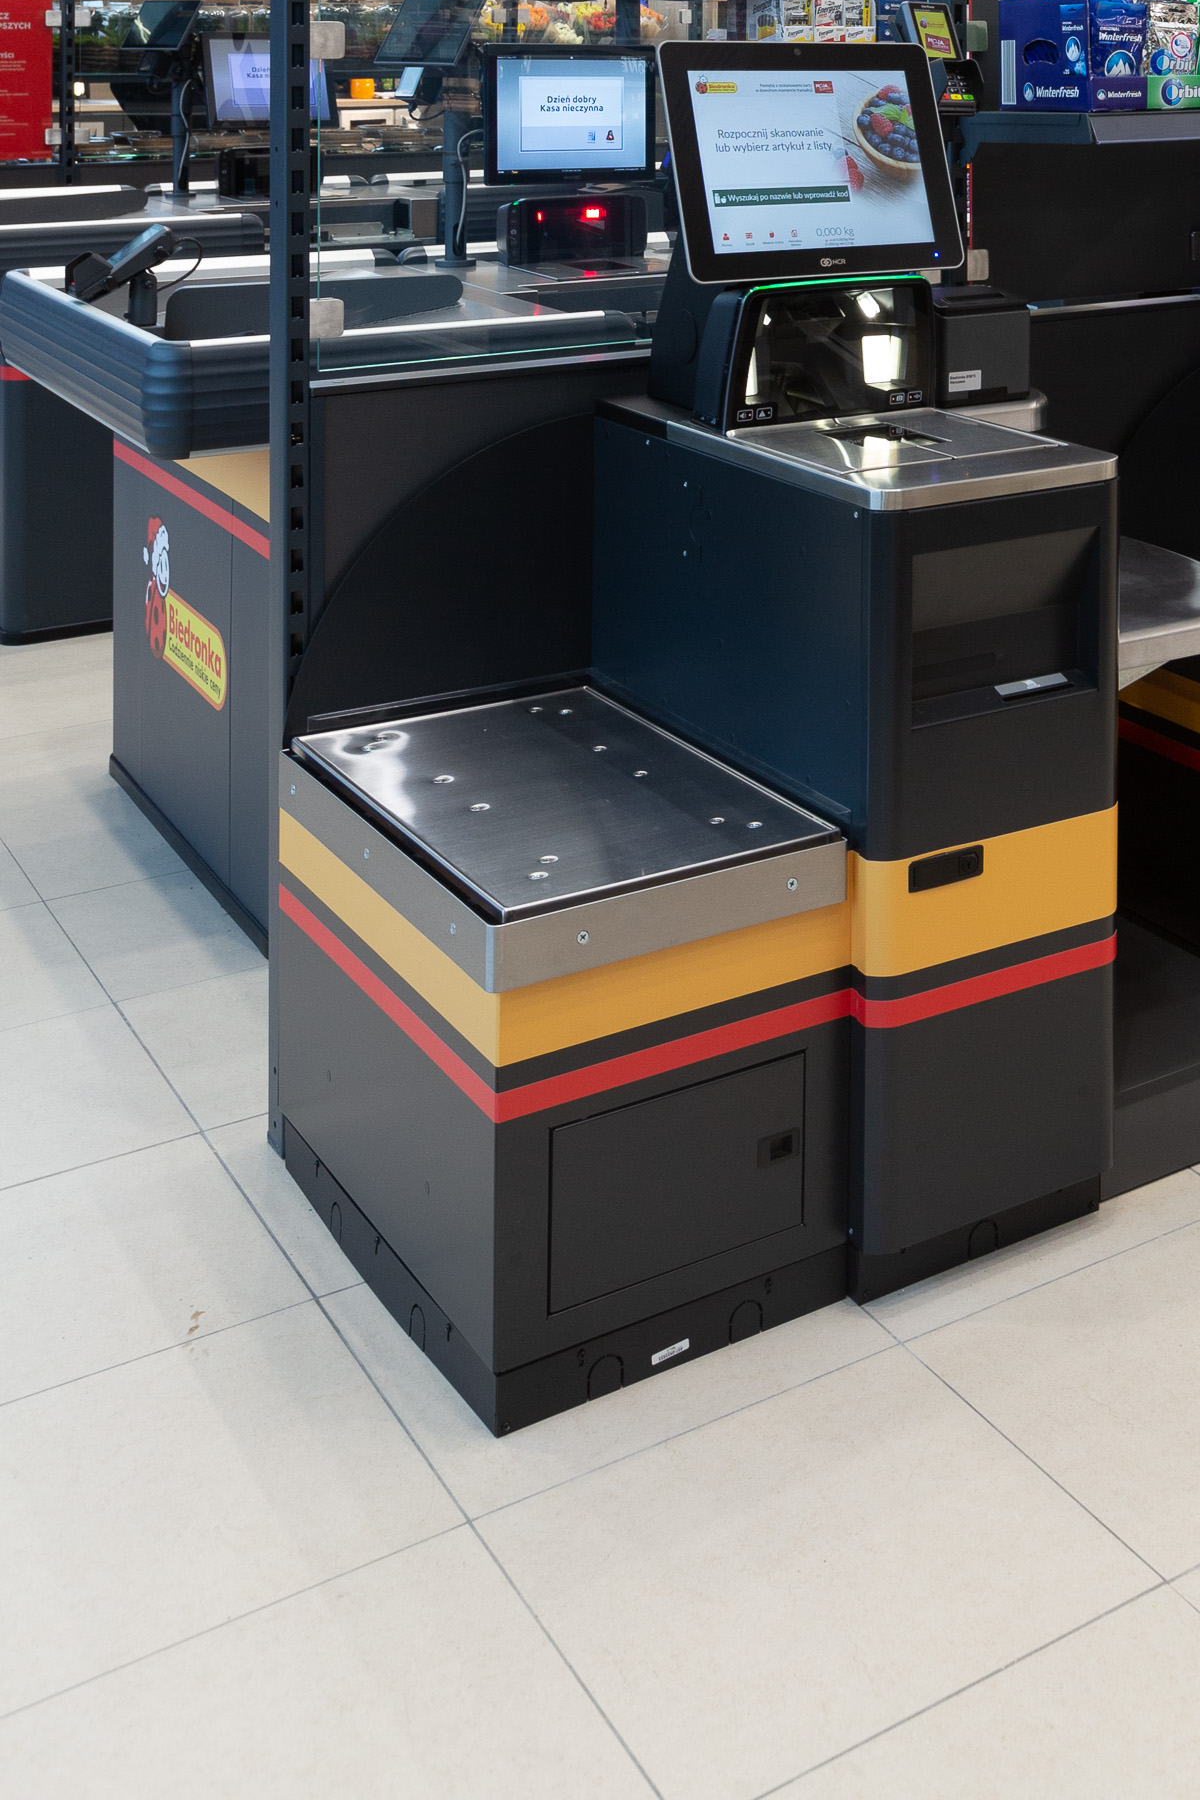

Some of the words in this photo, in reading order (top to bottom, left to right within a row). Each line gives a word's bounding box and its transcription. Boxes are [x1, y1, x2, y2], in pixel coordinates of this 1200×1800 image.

[818, 3, 842, 15] Energizer
[1098, 31, 1143, 43] Winterfresh
[1152, 51, 1193, 73] Orbit
[1036, 86, 1080, 98] Winterfresh
[1107, 90, 1142, 99] Winterfresh
[546, 95, 571, 104] Dzień
[572, 95, 597, 105] dobry
[562, 104, 604, 114] nieczynna
[717, 128, 769, 140] Rozpocznij
[770, 127, 824, 138] skanowanie
[715, 143, 731, 153] lub
[732, 142, 770, 154] wybierz
[772, 141, 805, 153] artykuł
[813, 141, 832, 152] listy
[727, 193, 759, 203] Wyszukaj
[760, 194, 769, 202] po
[769, 192, 792, 201] nazwie
[803, 191, 836, 201] wprowadź
[836, 190, 849, 198] kod
[843, 226, 855, 238] kg
[168, 602, 222, 680] Biedronka
[168, 636, 194, 672] Codziennie
[194, 662, 209, 687] niskie
[209, 677, 222, 700] ceny
